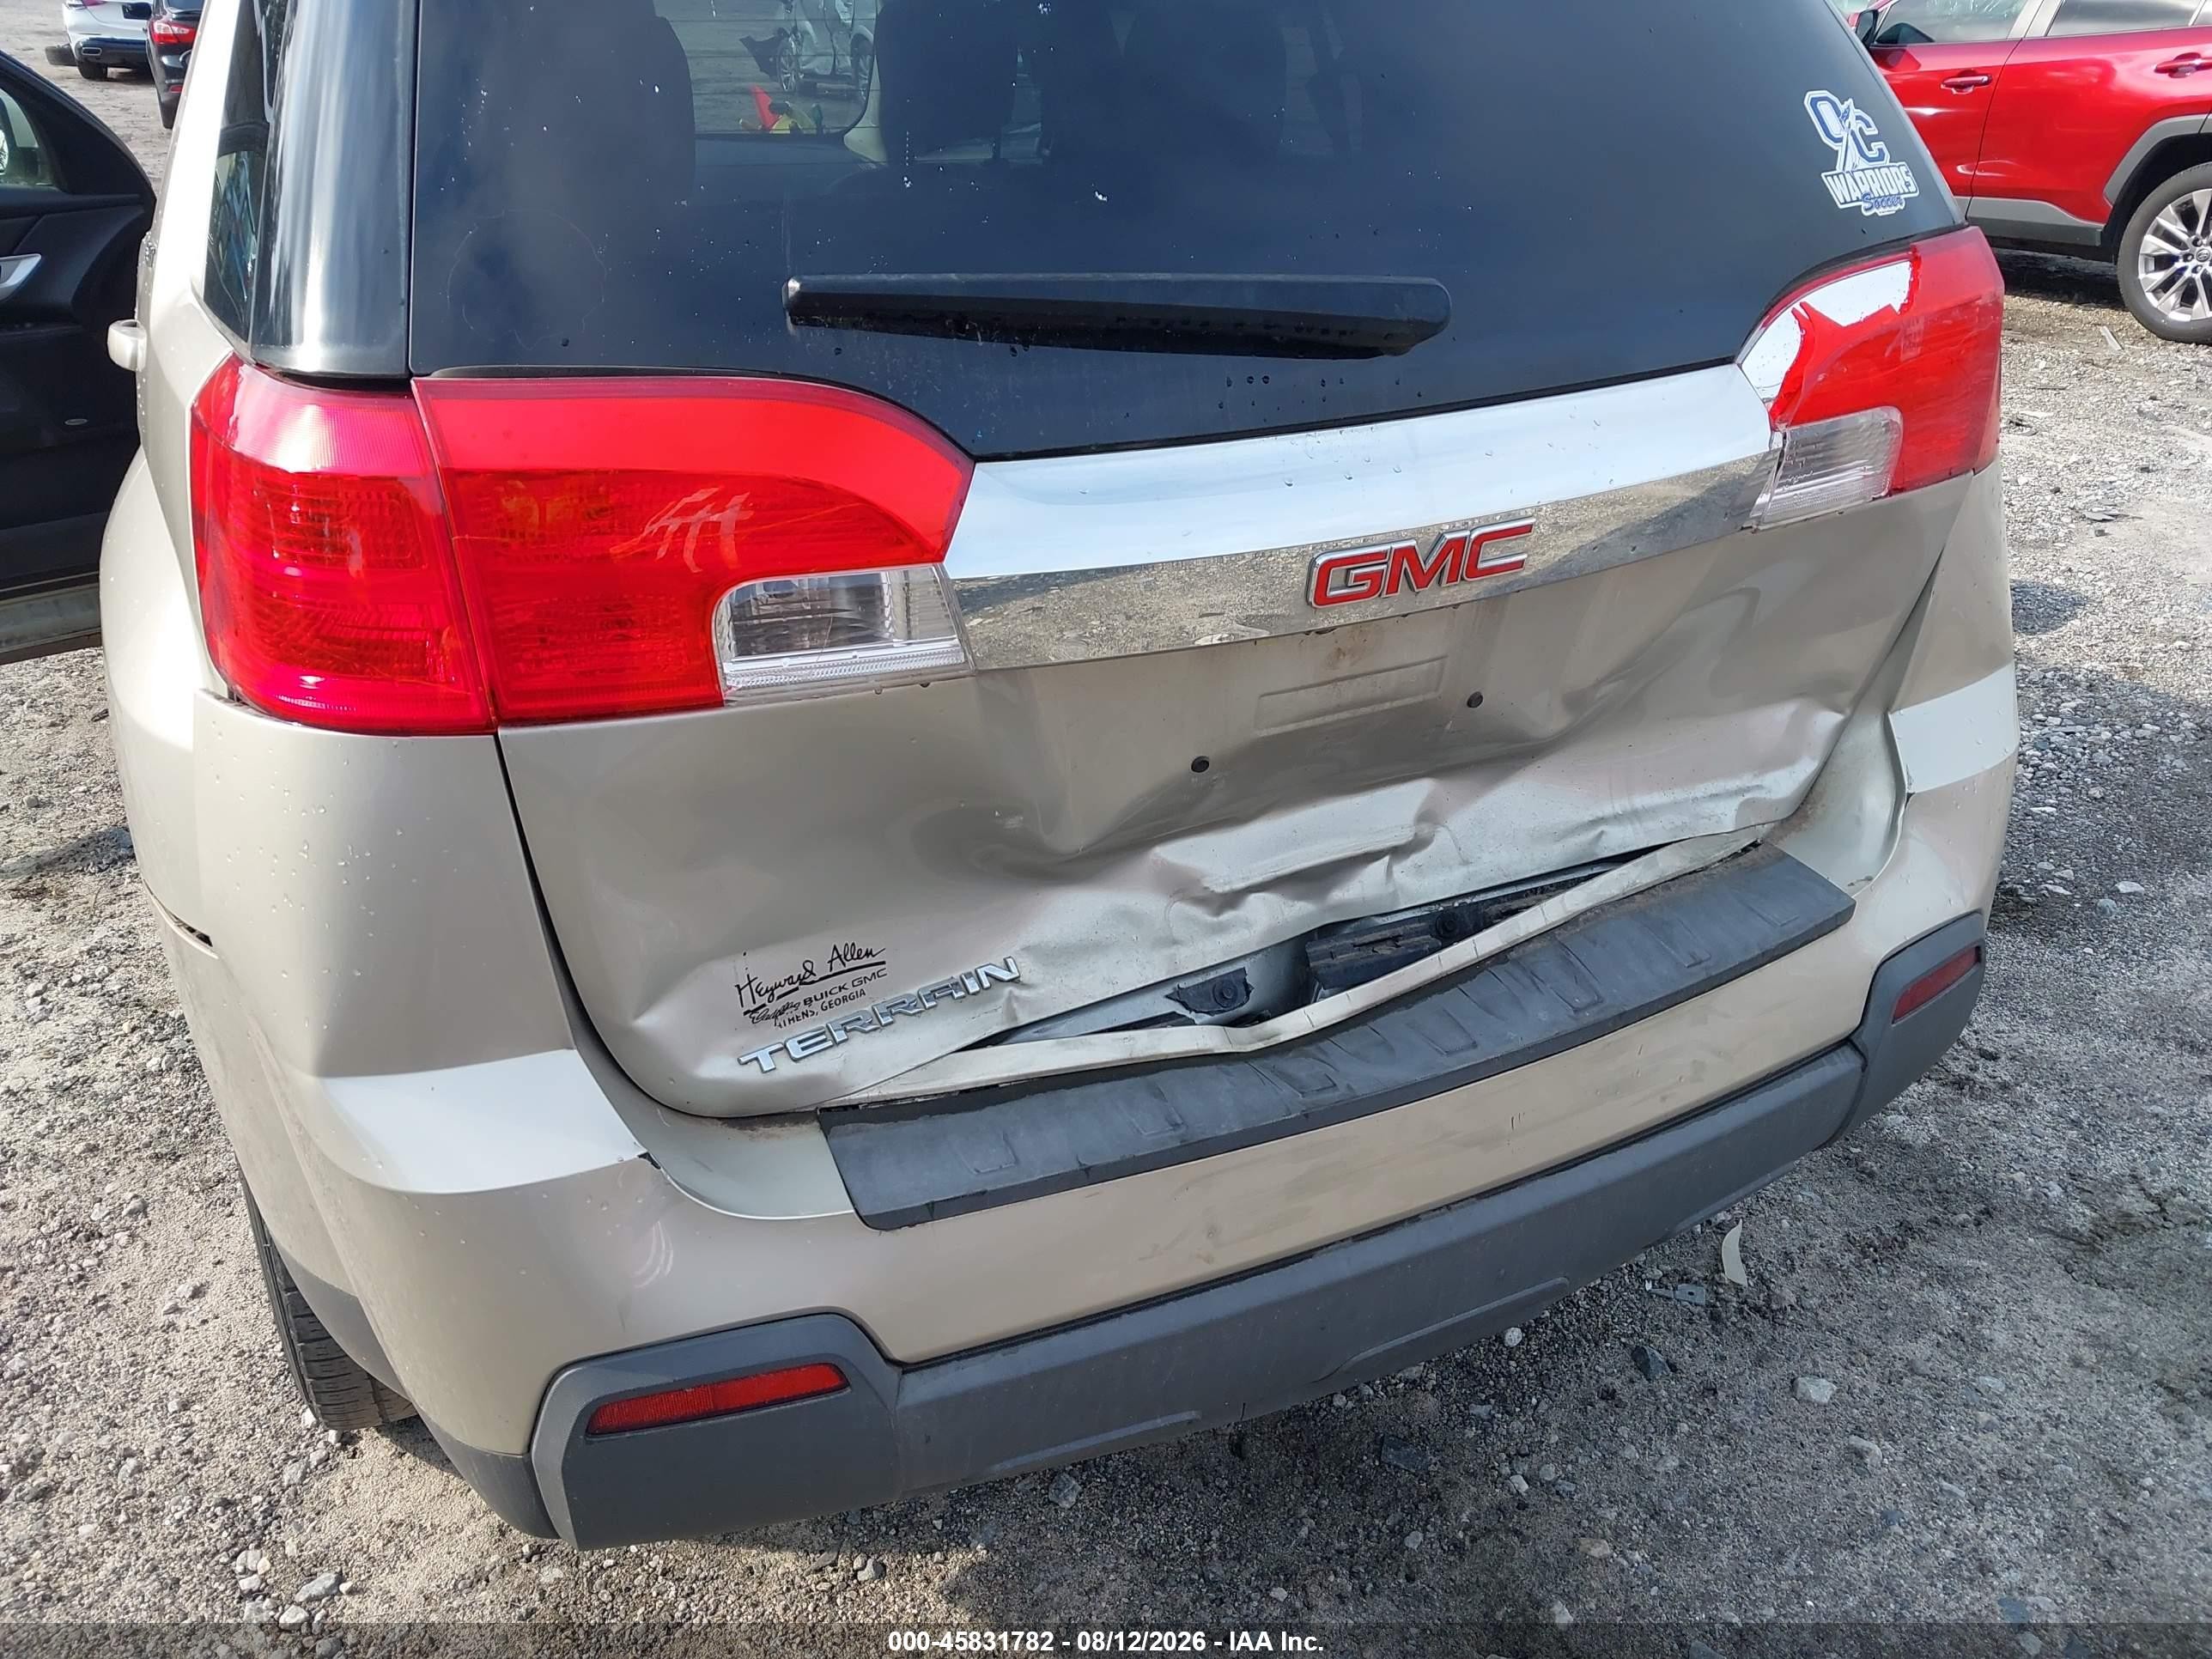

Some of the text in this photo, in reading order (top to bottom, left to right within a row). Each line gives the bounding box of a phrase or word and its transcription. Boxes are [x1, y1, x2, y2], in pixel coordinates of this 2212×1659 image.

[1826, 165, 1917, 204] WARRIORS
[1861, 191, 1904, 211] Soccer
[1306, 516, 1536, 608] GMC
[827, 941, 886, 972] Allen
[803, 982, 849, 1007] BUICK
[851, 968, 888, 988] GMC
[820, 988, 866, 1012] GEORGIA
[737, 956, 1021, 1074] TERRAIN
